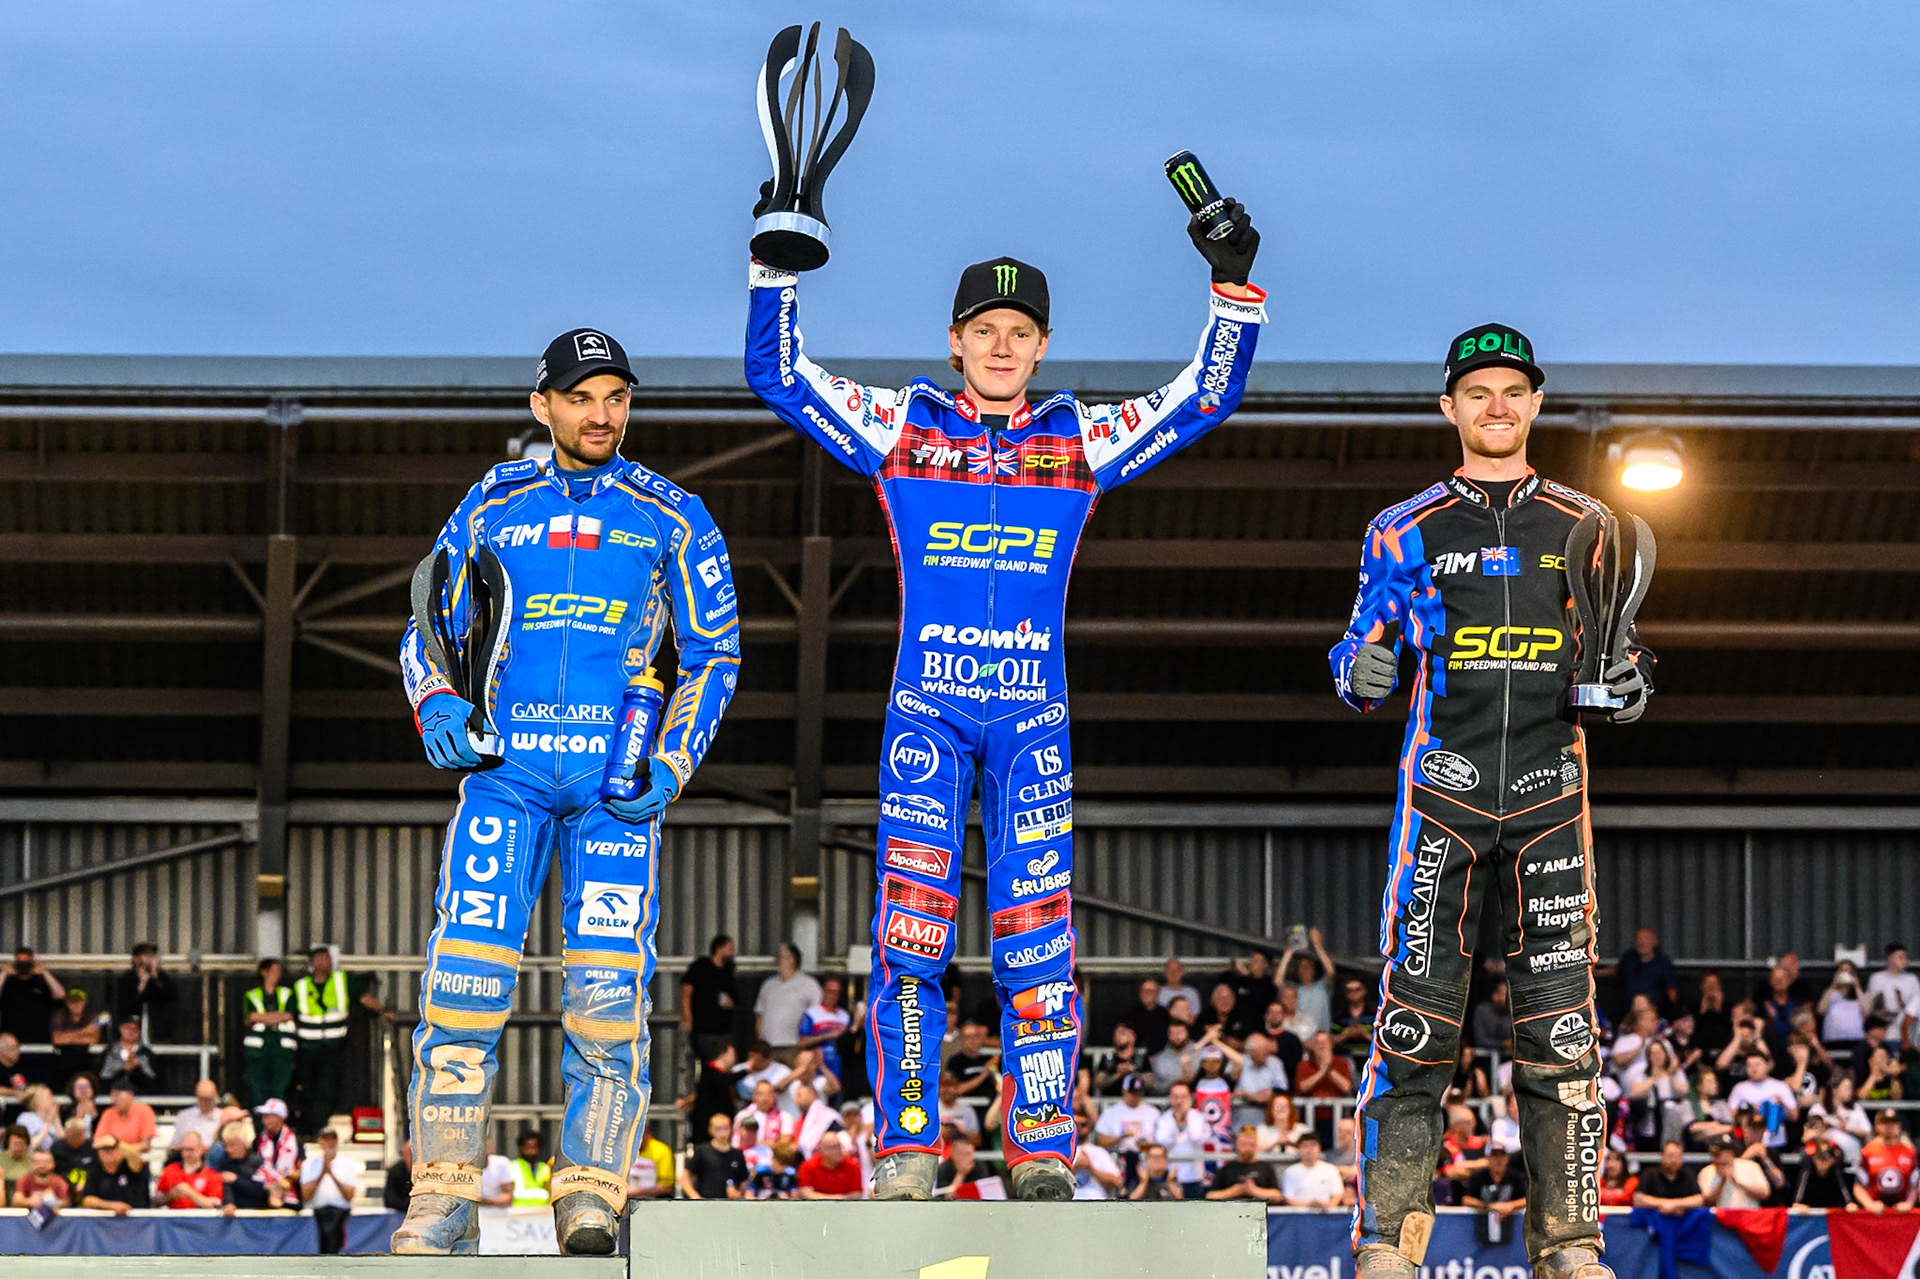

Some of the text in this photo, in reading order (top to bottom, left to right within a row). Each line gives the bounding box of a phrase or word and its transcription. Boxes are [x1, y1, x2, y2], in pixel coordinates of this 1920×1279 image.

[779, 303, 795, 387] IMMERGAS
[1202, 320, 1232, 391] KRAJEWSKI
[1213, 322, 1243, 394] KONSTRUKCJE
[1457, 332, 1530, 362] BOLL
[501, 463, 532, 473] ORLEN
[911, 443, 963, 468] FIM
[1024, 454, 1070, 469] SGP
[491, 523, 546, 549] FIM
[607, 529, 657, 549] SGP
[925, 521, 1035, 555] SGP
[923, 554, 1048, 575] FIM SPEEDWAY GRAND PRIX
[1430, 552, 1478, 577] FIM
[523, 593, 607, 619] SGP
[522, 619, 617, 636] FIM SPEEDWAY GRAND PRIX
[1450, 626, 1563, 660] SGP
[625, 648, 645, 667] 95
[920, 651, 1047, 687] BIO OIL
[1448, 660, 1558, 672] FIM SPEEDWAY GRAND PRIX
[511, 702, 615, 722] GARCAREK
[902, 693, 941, 719] WIKO
[1016, 707, 1060, 734] BATEX
[511, 732, 607, 753] wecon
[624, 708, 649, 765] verva
[895, 746, 931, 769] ATPI
[1030, 745, 1063, 777] US
[1424, 760, 1440, 772] Joe
[1440, 766, 1473, 786] Hughes
[1510, 768, 1558, 792] EASTERN
[1019, 772, 1073, 803] CLINIC
[1519, 778, 1551, 795] POINT
[504, 826, 516, 873] Logistics
[585, 834, 648, 858] verva
[451, 816, 507, 930] MCG
[888, 851, 941, 874] Alpodach
[1542, 854, 1586, 874] ANLAS
[1404, 834, 1446, 977] GARCAREK
[1528, 889, 1589, 913] Richard
[587, 916, 629, 928] ORLEN
[890, 916, 946, 946] AMD
[1537, 908, 1585, 928] Hayes
[889, 936, 939, 955] GROUP
[1004, 932, 1072, 966] GARCAREK
[1529, 948, 1588, 968] MOTOREX
[433, 971, 501, 998] PROFBUD
[585, 970, 619, 980] ORLEN
[584, 980, 633, 1006] Team
[1020, 1048, 1065, 1081] MOON
[1023, 1071, 1066, 1104] BITE
[422, 1105, 485, 1122] ORLEN
[605, 1089, 628, 1164] Grohmann
[443, 1126, 470, 1140] OIL
[584, 1111, 598, 1144] Broker
[1565, 1112, 1579, 1223] Flooring by Brights
[1579, 1112, 1604, 1223] Choices
